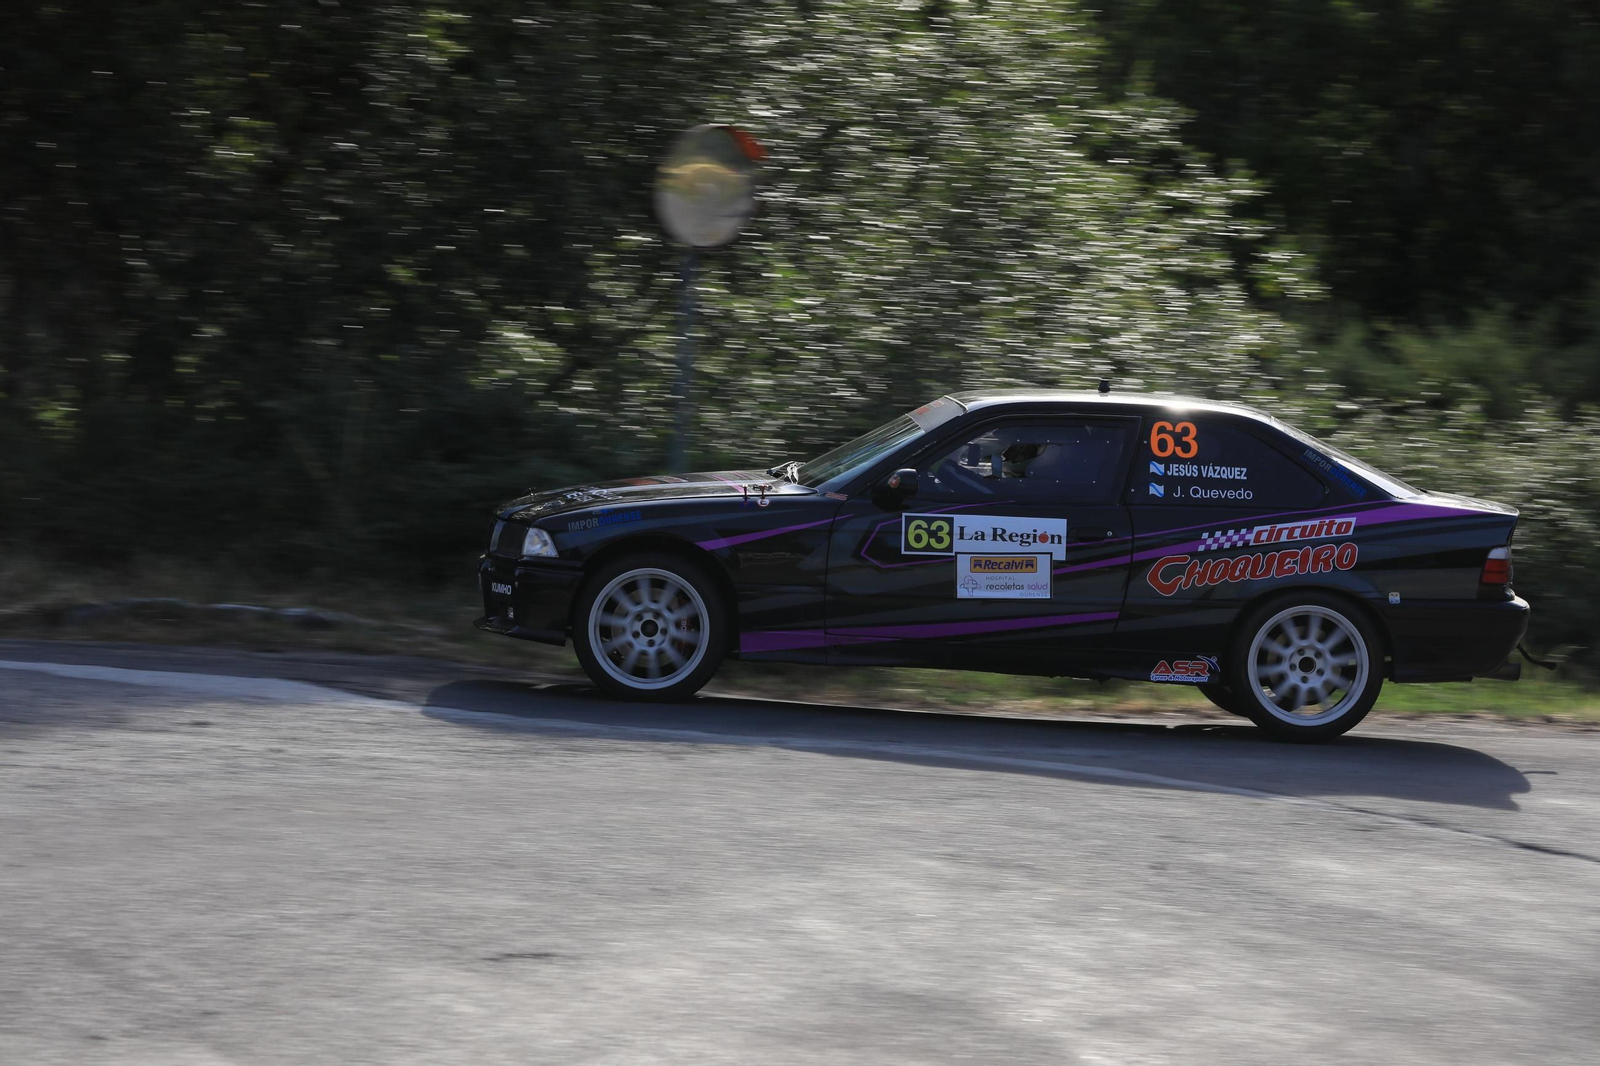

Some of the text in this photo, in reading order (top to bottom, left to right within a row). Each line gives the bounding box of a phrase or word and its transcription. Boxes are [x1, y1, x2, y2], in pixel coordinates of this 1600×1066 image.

[1150, 421, 1198, 459] 63
[1167, 461, 1247, 480] JESÚS VÁZQUEZ
[1173, 485, 1253, 500] J. Quevedo
[567, 510, 641, 532] IMPOROURENSE
[907, 519, 951, 550] 63
[957, 525, 1063, 547] La Región
[1252, 519, 1354, 544] circuito
[983, 559, 1025, 571] Recalvi
[1147, 541, 1359, 597] CHOQUEIRO
[491, 581, 512, 596] KUMHO
[985, 582, 1048, 591] recoletas salud
[1151, 659, 1211, 677] ASR
